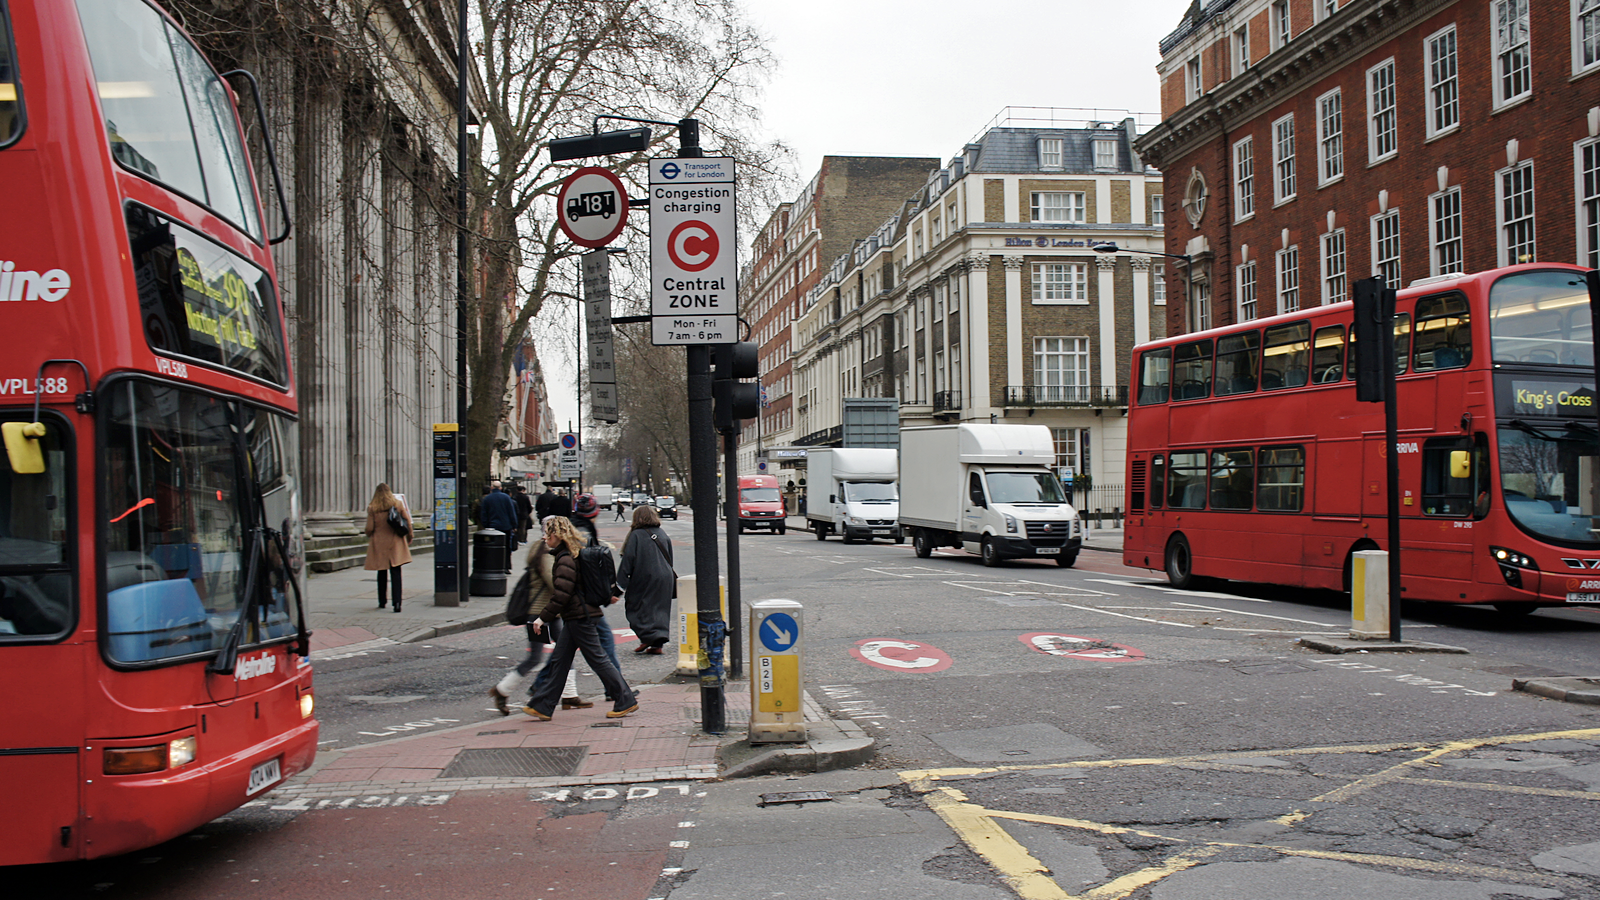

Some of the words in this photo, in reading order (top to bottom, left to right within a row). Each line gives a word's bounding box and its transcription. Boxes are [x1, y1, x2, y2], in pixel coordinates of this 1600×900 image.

[684, 163, 721, 171] Transport
[583, 193, 612, 213] 18T
[655, 187, 730, 201] Congestion
[664, 201, 721, 213] charging
[1005, 237, 1032, 247] Hilton
[1052, 238, 1084, 247] London
[221, 270, 250, 316] 390
[663, 277, 725, 291] Central
[669, 295, 719, 308] ZONE
[184, 301, 221, 345] Notting
[673, 320, 694, 328] Mon
[703, 319, 716, 328] Fri
[155, 357, 188, 379] VPL588
[0, 377, 68, 395] VPL588
[1517, 389, 1553, 409] King's
[1557, 391, 1592, 407] Cross
[234, 651, 276, 681] Metroline
[357, 717, 460, 737] LOOK
[531, 784, 691, 802] LOOK
